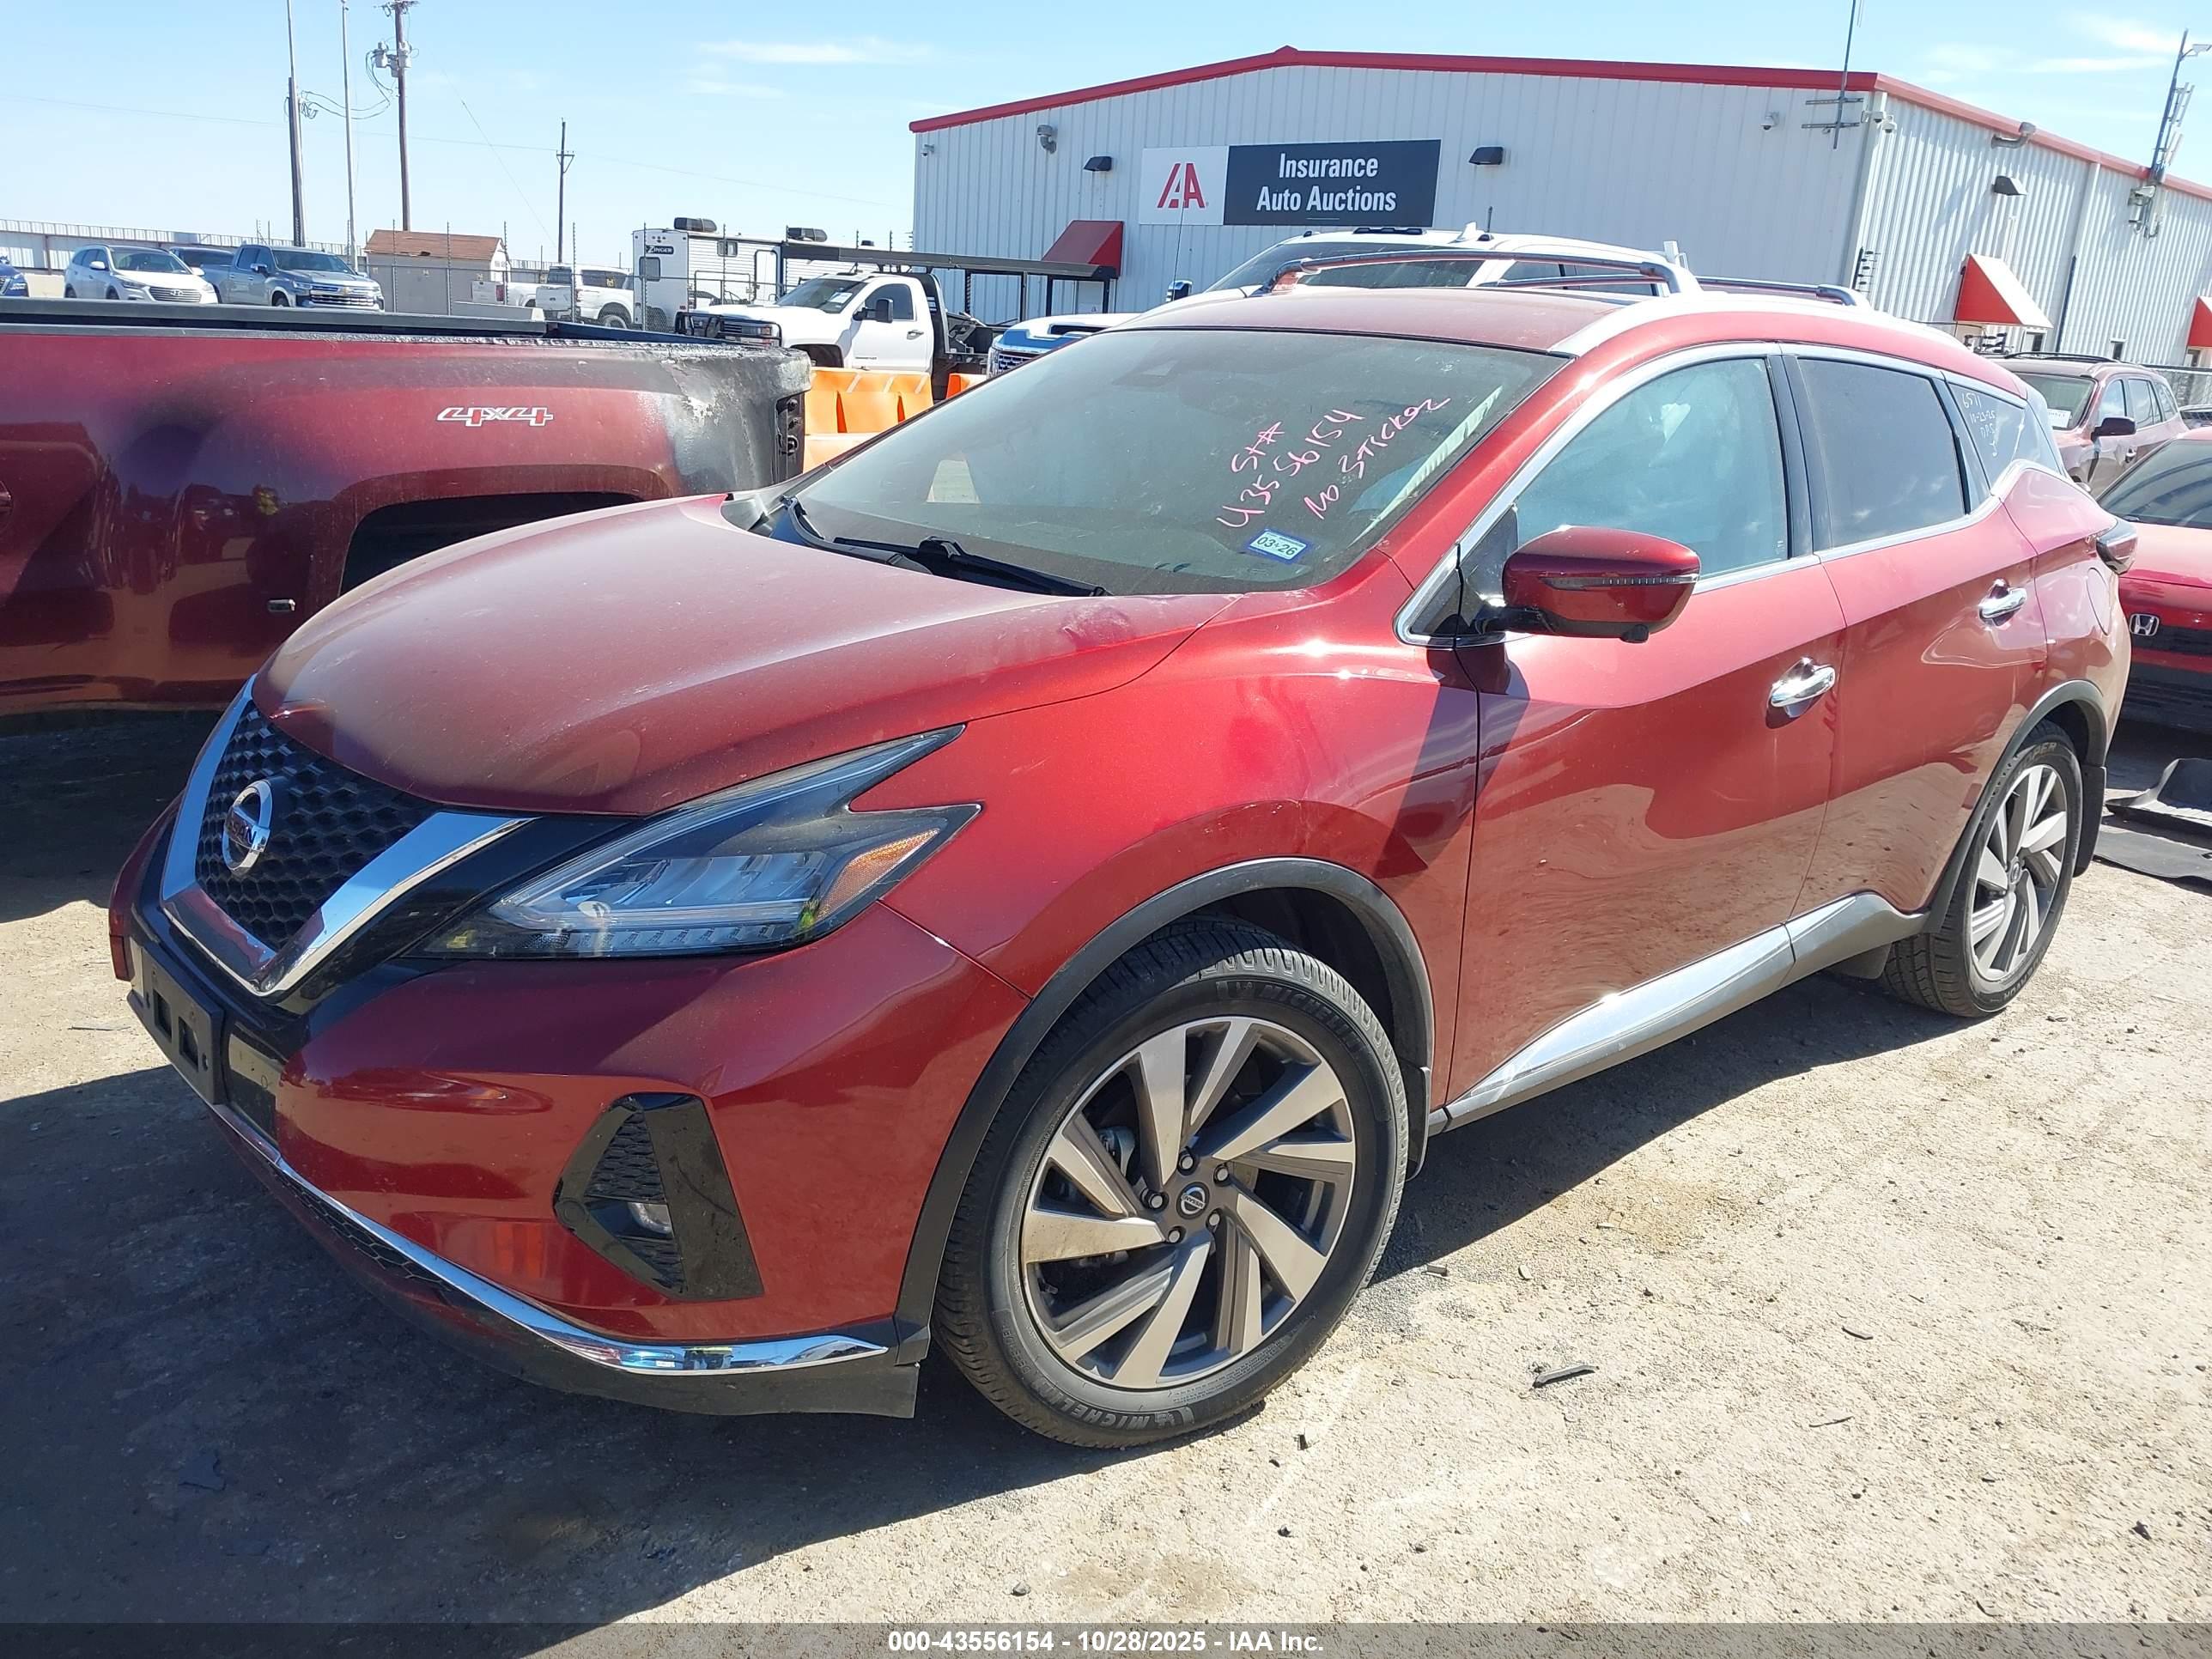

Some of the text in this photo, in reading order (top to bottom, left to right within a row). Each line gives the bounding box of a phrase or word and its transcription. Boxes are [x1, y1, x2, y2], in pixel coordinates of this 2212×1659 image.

[1279, 153, 1379, 179] Insurance
[1256, 185, 1397, 211] Auto Auctions
[1256, 537, 1276, 548] 03
[1278, 544, 1298, 556] 26
[1032, 1376, 1151, 1430] MICHELIN
